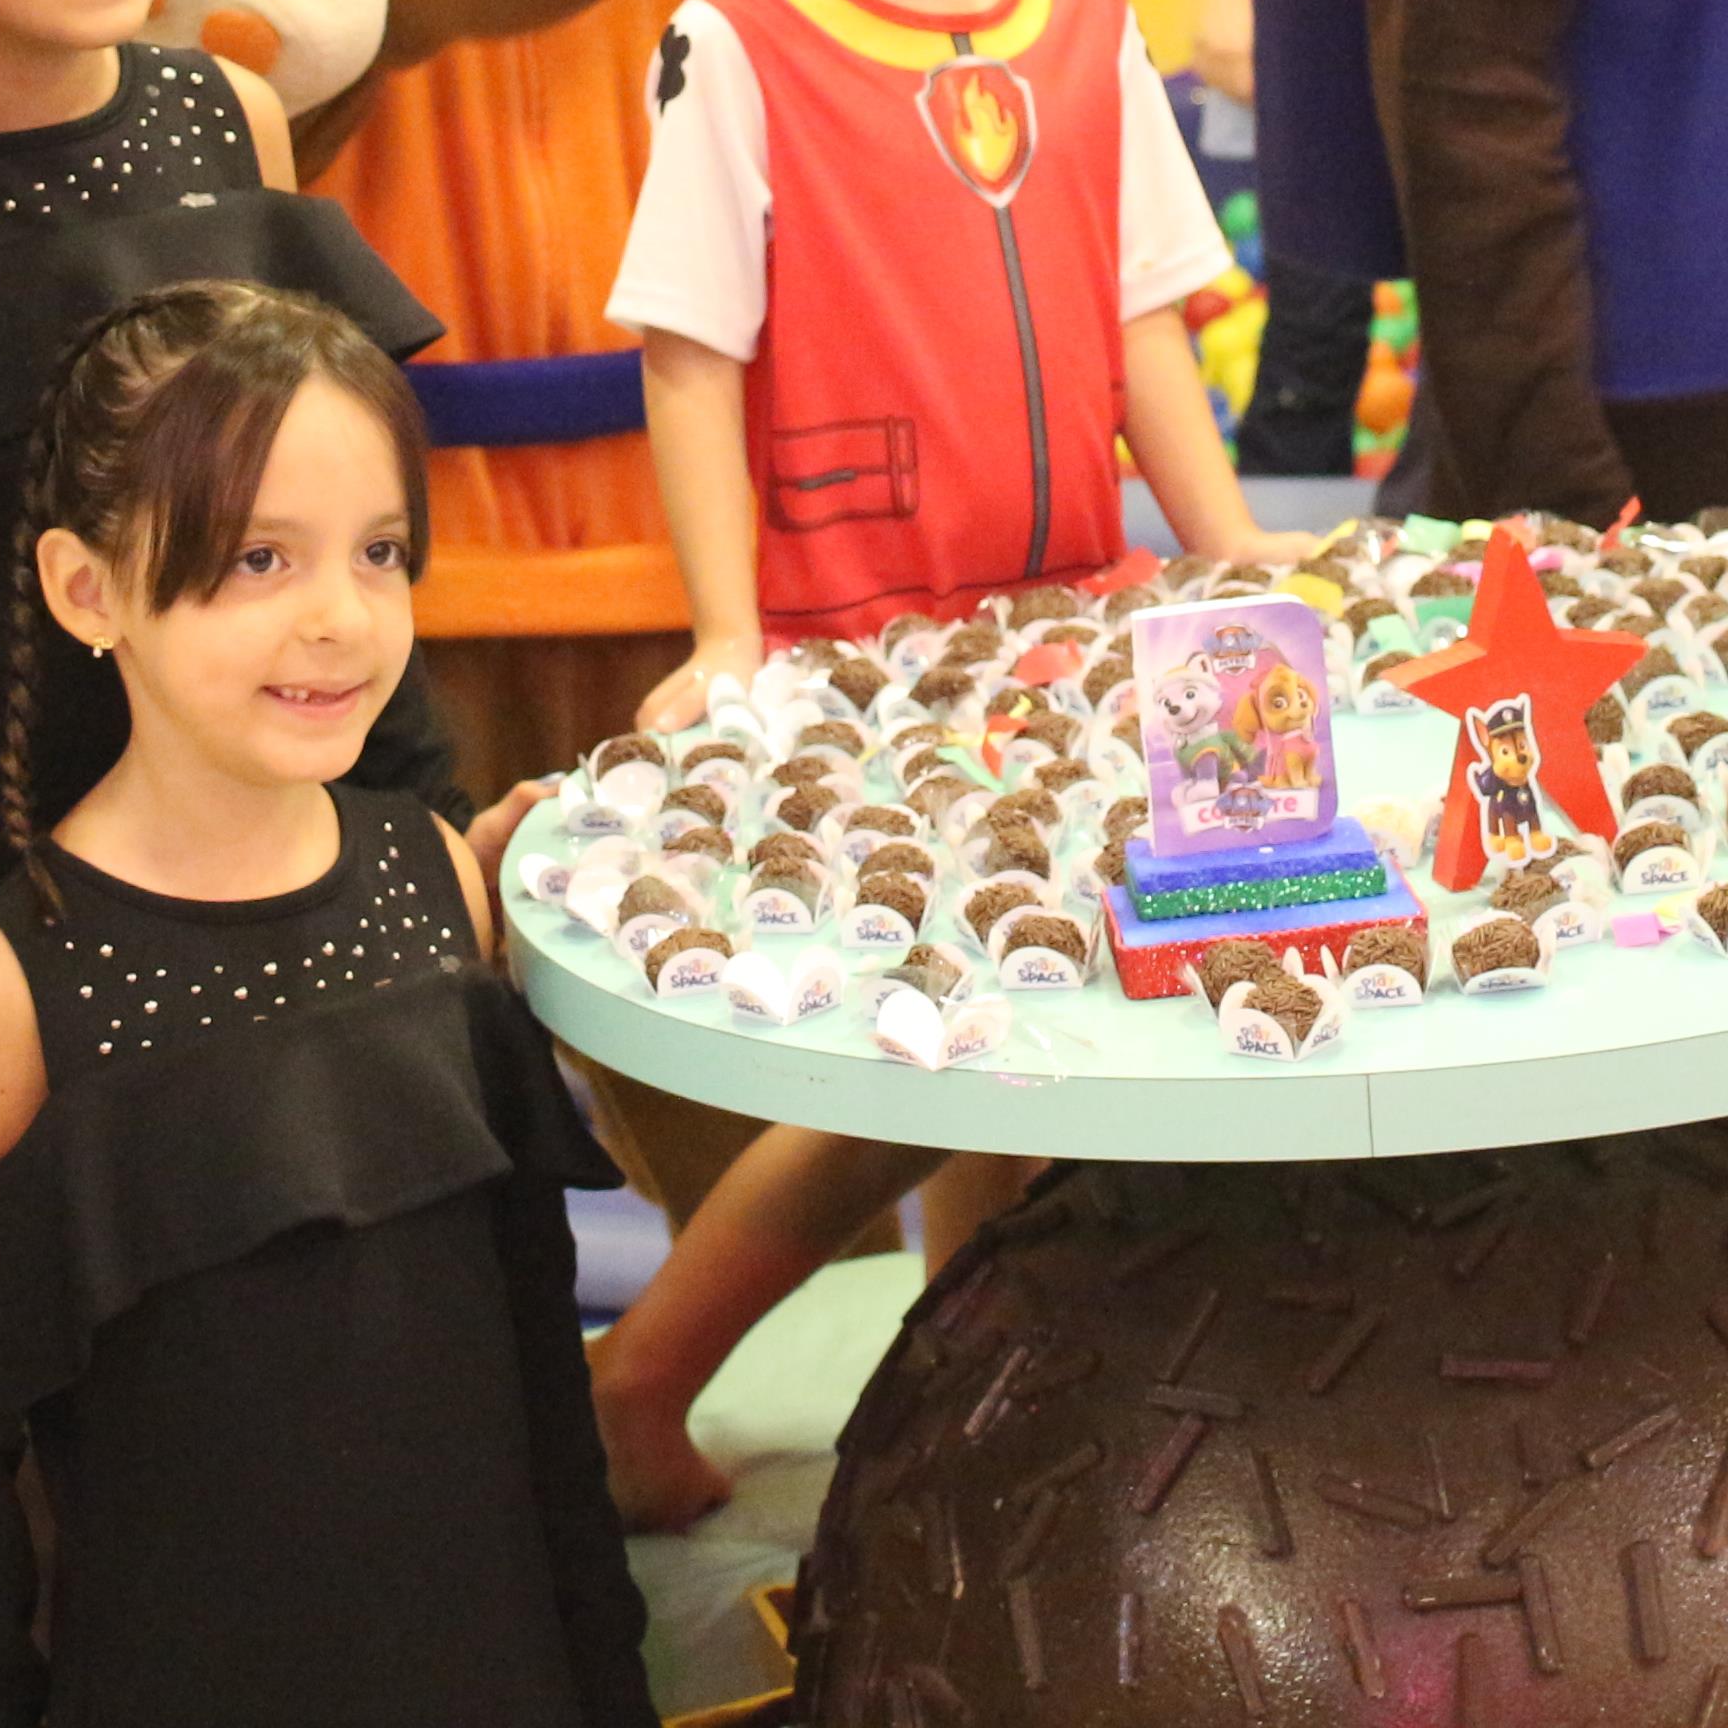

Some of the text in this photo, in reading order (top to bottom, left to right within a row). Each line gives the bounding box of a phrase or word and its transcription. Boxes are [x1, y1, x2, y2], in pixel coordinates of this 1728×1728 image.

[1198, 797, 1298, 824] cote
[1641, 870, 1689, 885] SPACE
[757, 912, 799, 924] SPACE
[856, 927, 904, 942] SPACE
[1556, 924, 1585, 940] ACE
[671, 972, 720, 988] SPACE
[1017, 969, 1068, 984] SPACE
[1356, 985, 1407, 1000] SPACE
[798, 991, 833, 1016] SPACE
[1237, 1036, 1283, 1055] SPACE
